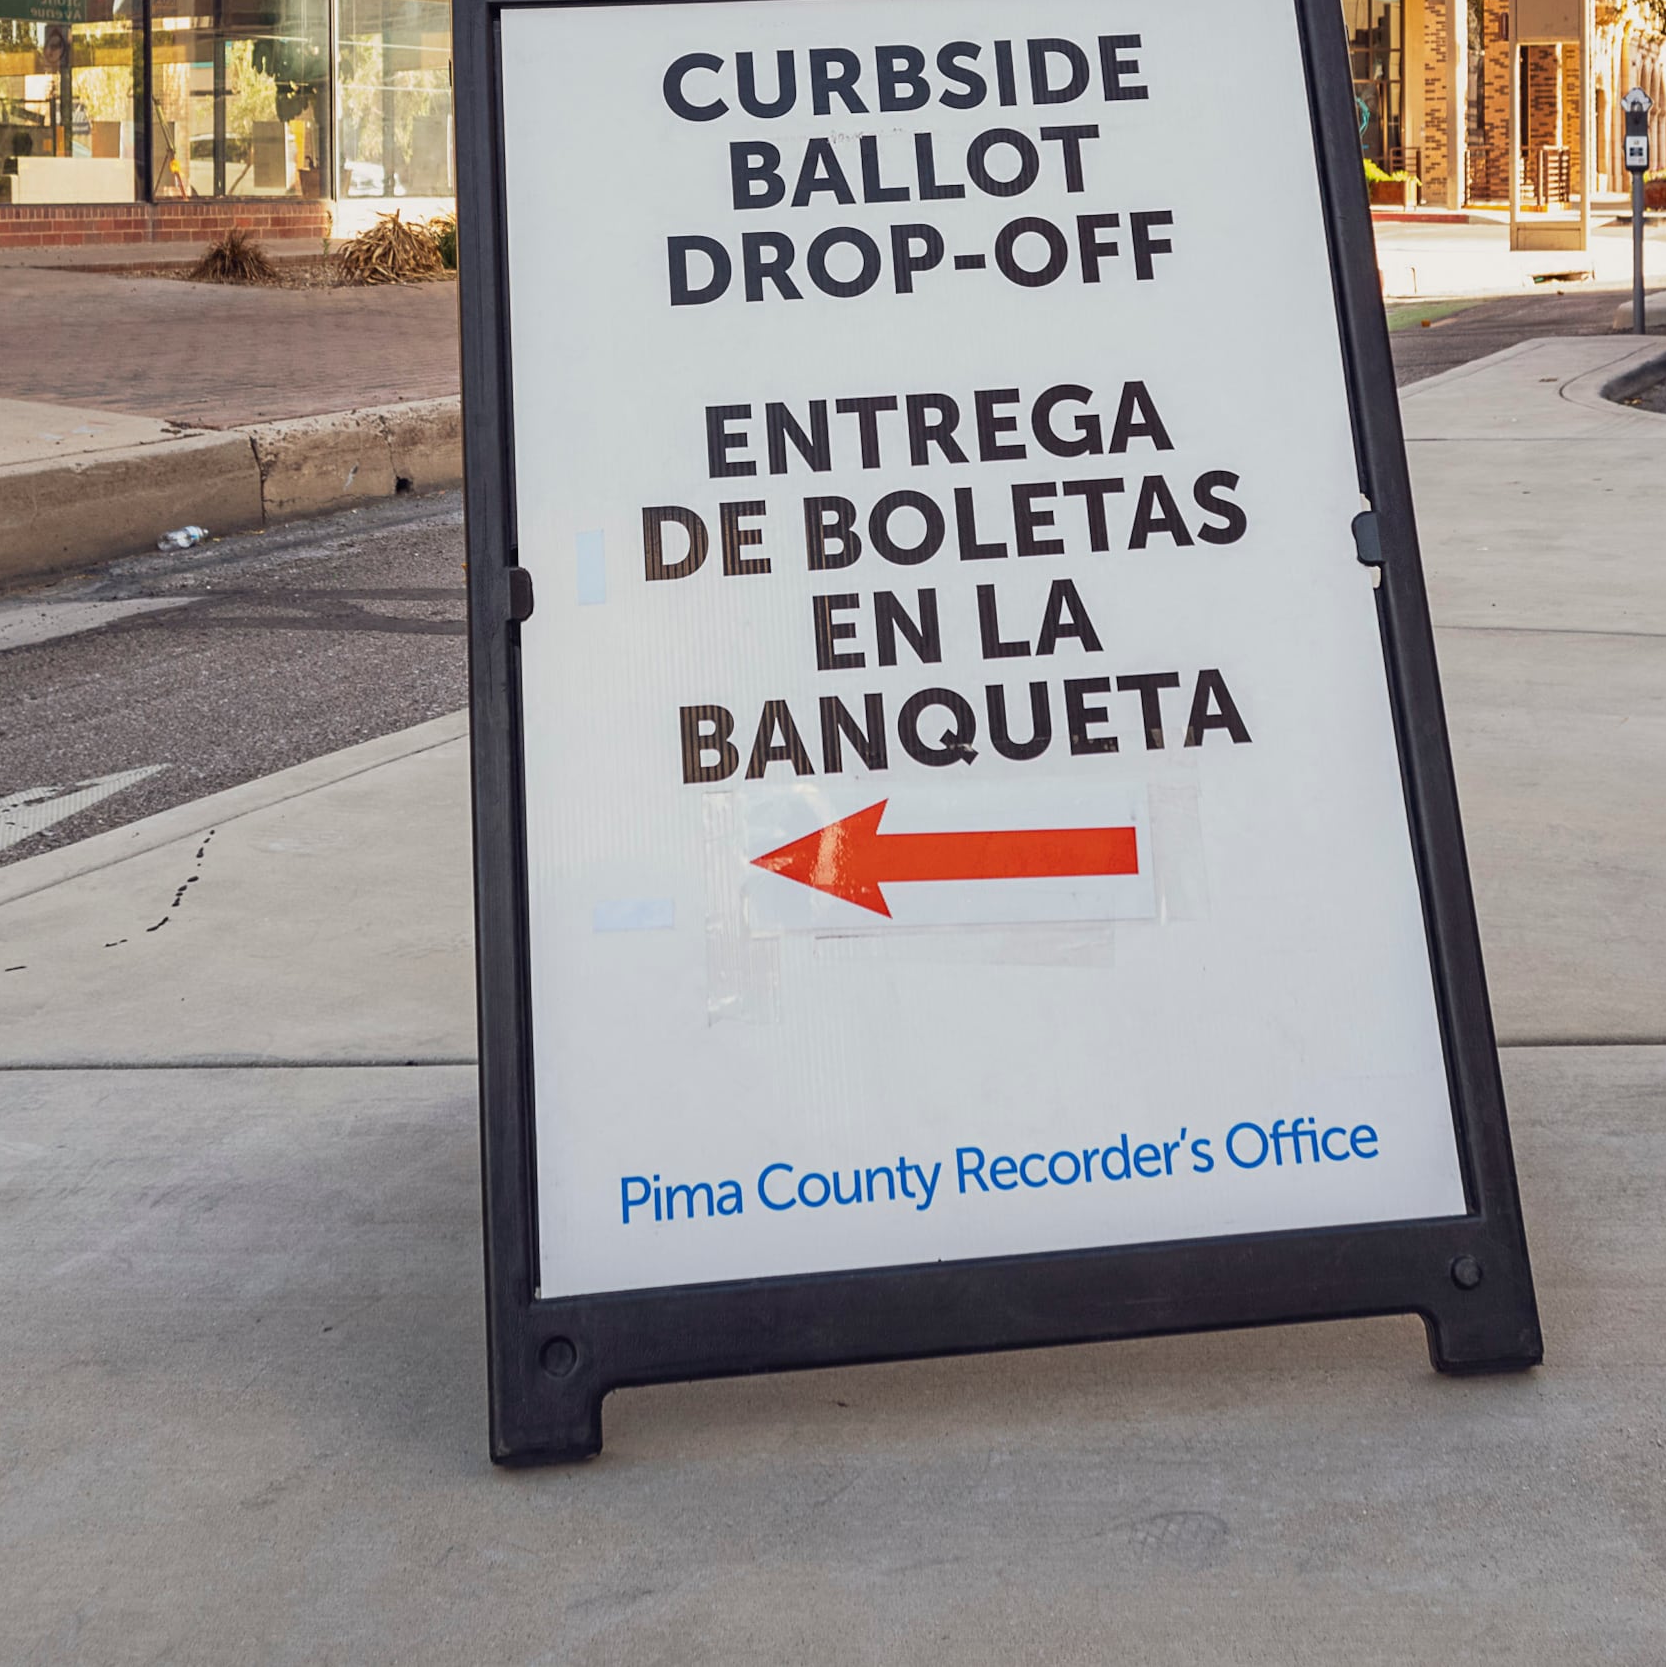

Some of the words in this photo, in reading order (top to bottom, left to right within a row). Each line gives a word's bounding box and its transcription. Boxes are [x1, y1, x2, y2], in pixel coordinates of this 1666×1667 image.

[663, 33, 1150, 122] CURBSIDE
[729, 124, 1100, 211] BALLOT
[666, 210, 1174, 307] DROP-OFF
[705, 380, 1175, 479] ENTREGA
[641, 499, 772, 582] DE
[803, 470, 1247, 572] BOLETAS
[812, 584, 945, 672] EN
[976, 578, 1104, 660] LA
[679, 668, 1253, 785] BANQUETA
[620, 1173, 744, 1225] Pima
[756, 1155, 942, 1212] County
[955, 1126, 1215, 1195] Recorder's
[1225, 1116, 1380, 1169] Office
